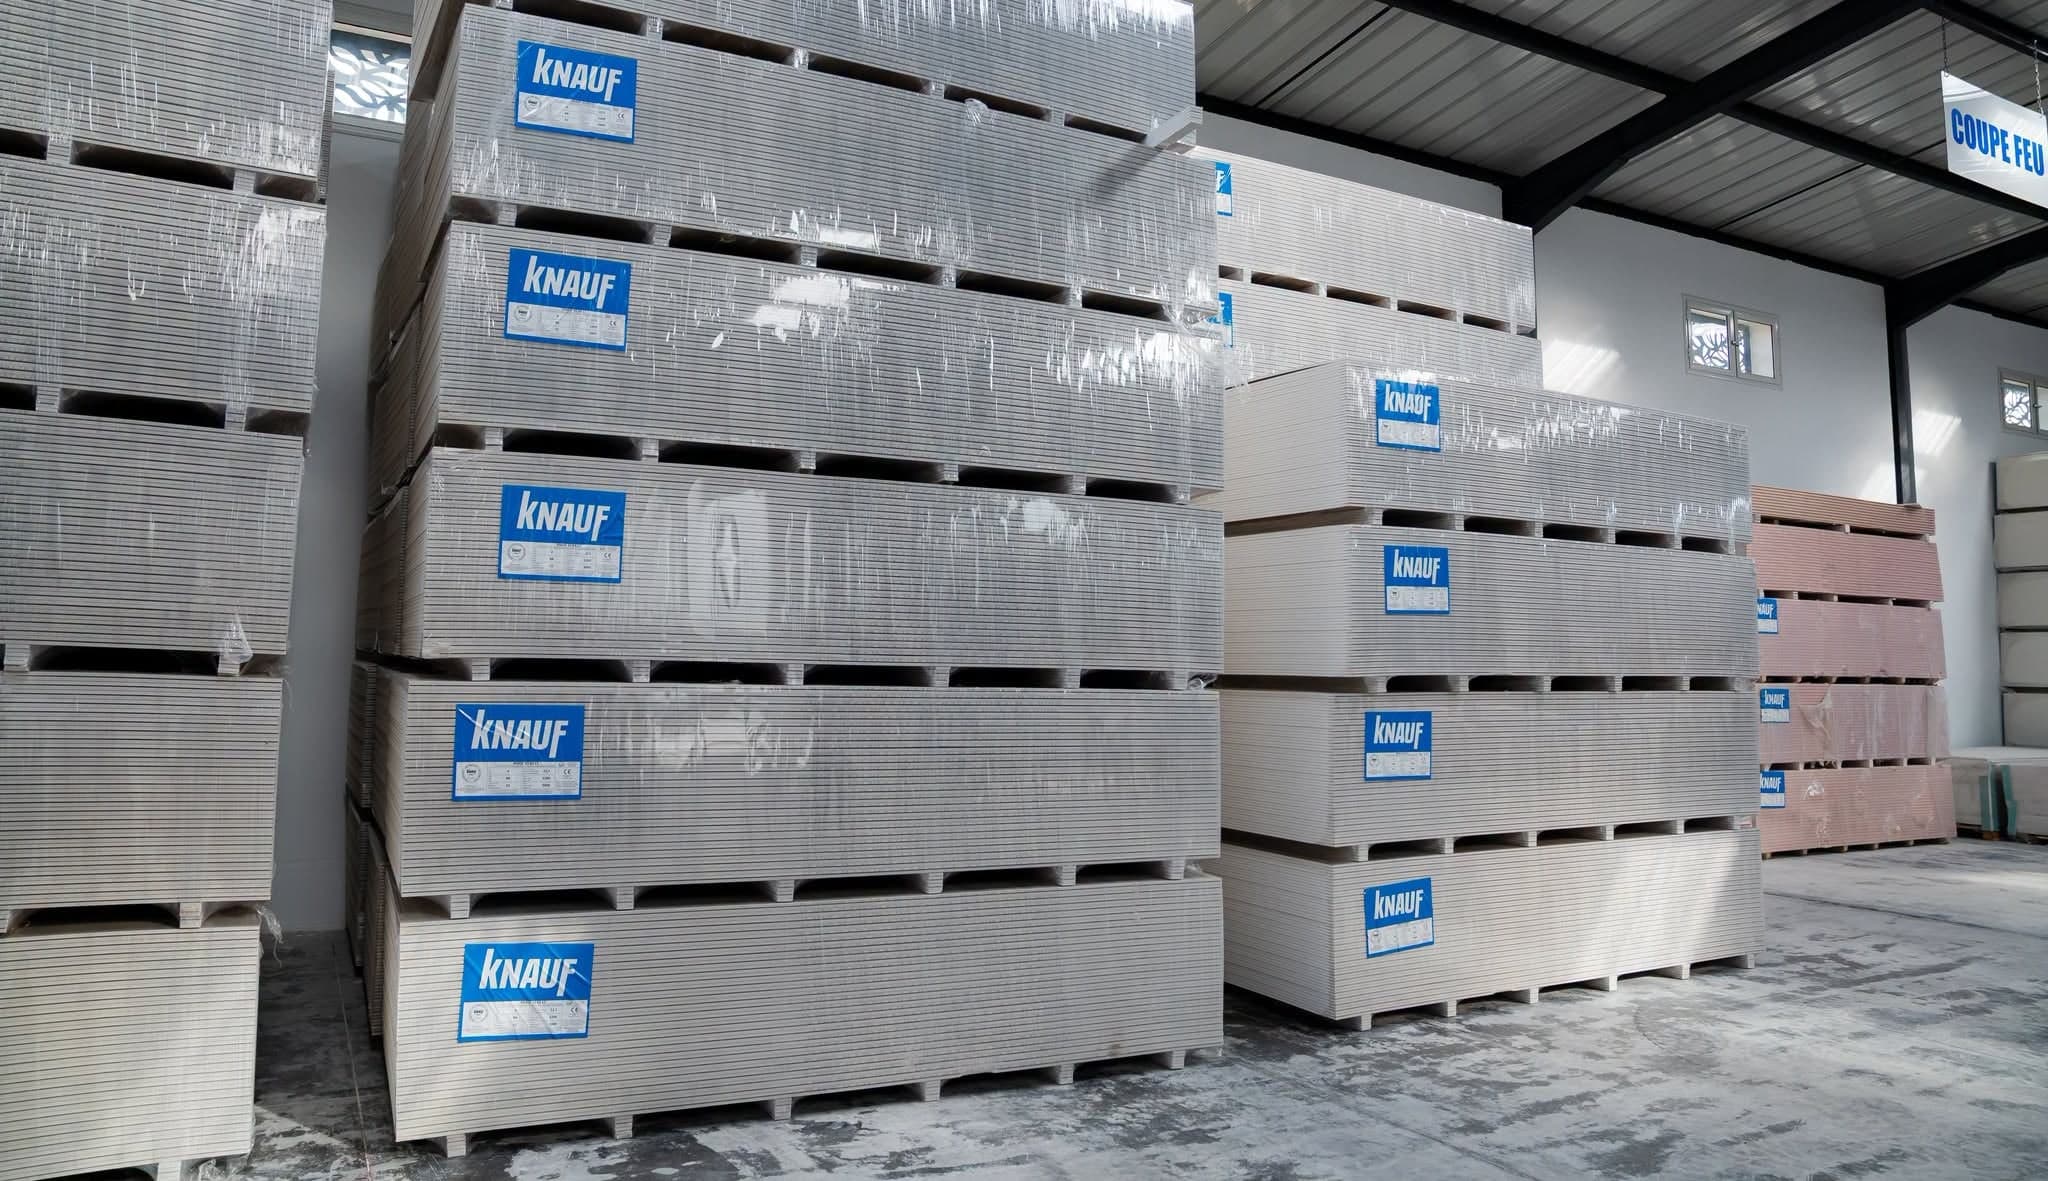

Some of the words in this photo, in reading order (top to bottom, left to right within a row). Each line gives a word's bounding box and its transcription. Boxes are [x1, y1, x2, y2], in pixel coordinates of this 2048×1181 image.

[533, 48, 622, 101] KNAUF
[1952, 108, 2010, 163] COUPE
[2015, 135, 2045, 177] FEU
[523, 255, 615, 309] KNAUF
[516, 490, 611, 541] KNAUF
[471, 709, 569, 759] KNAUF
[479, 948, 578, 996] KNAUF
